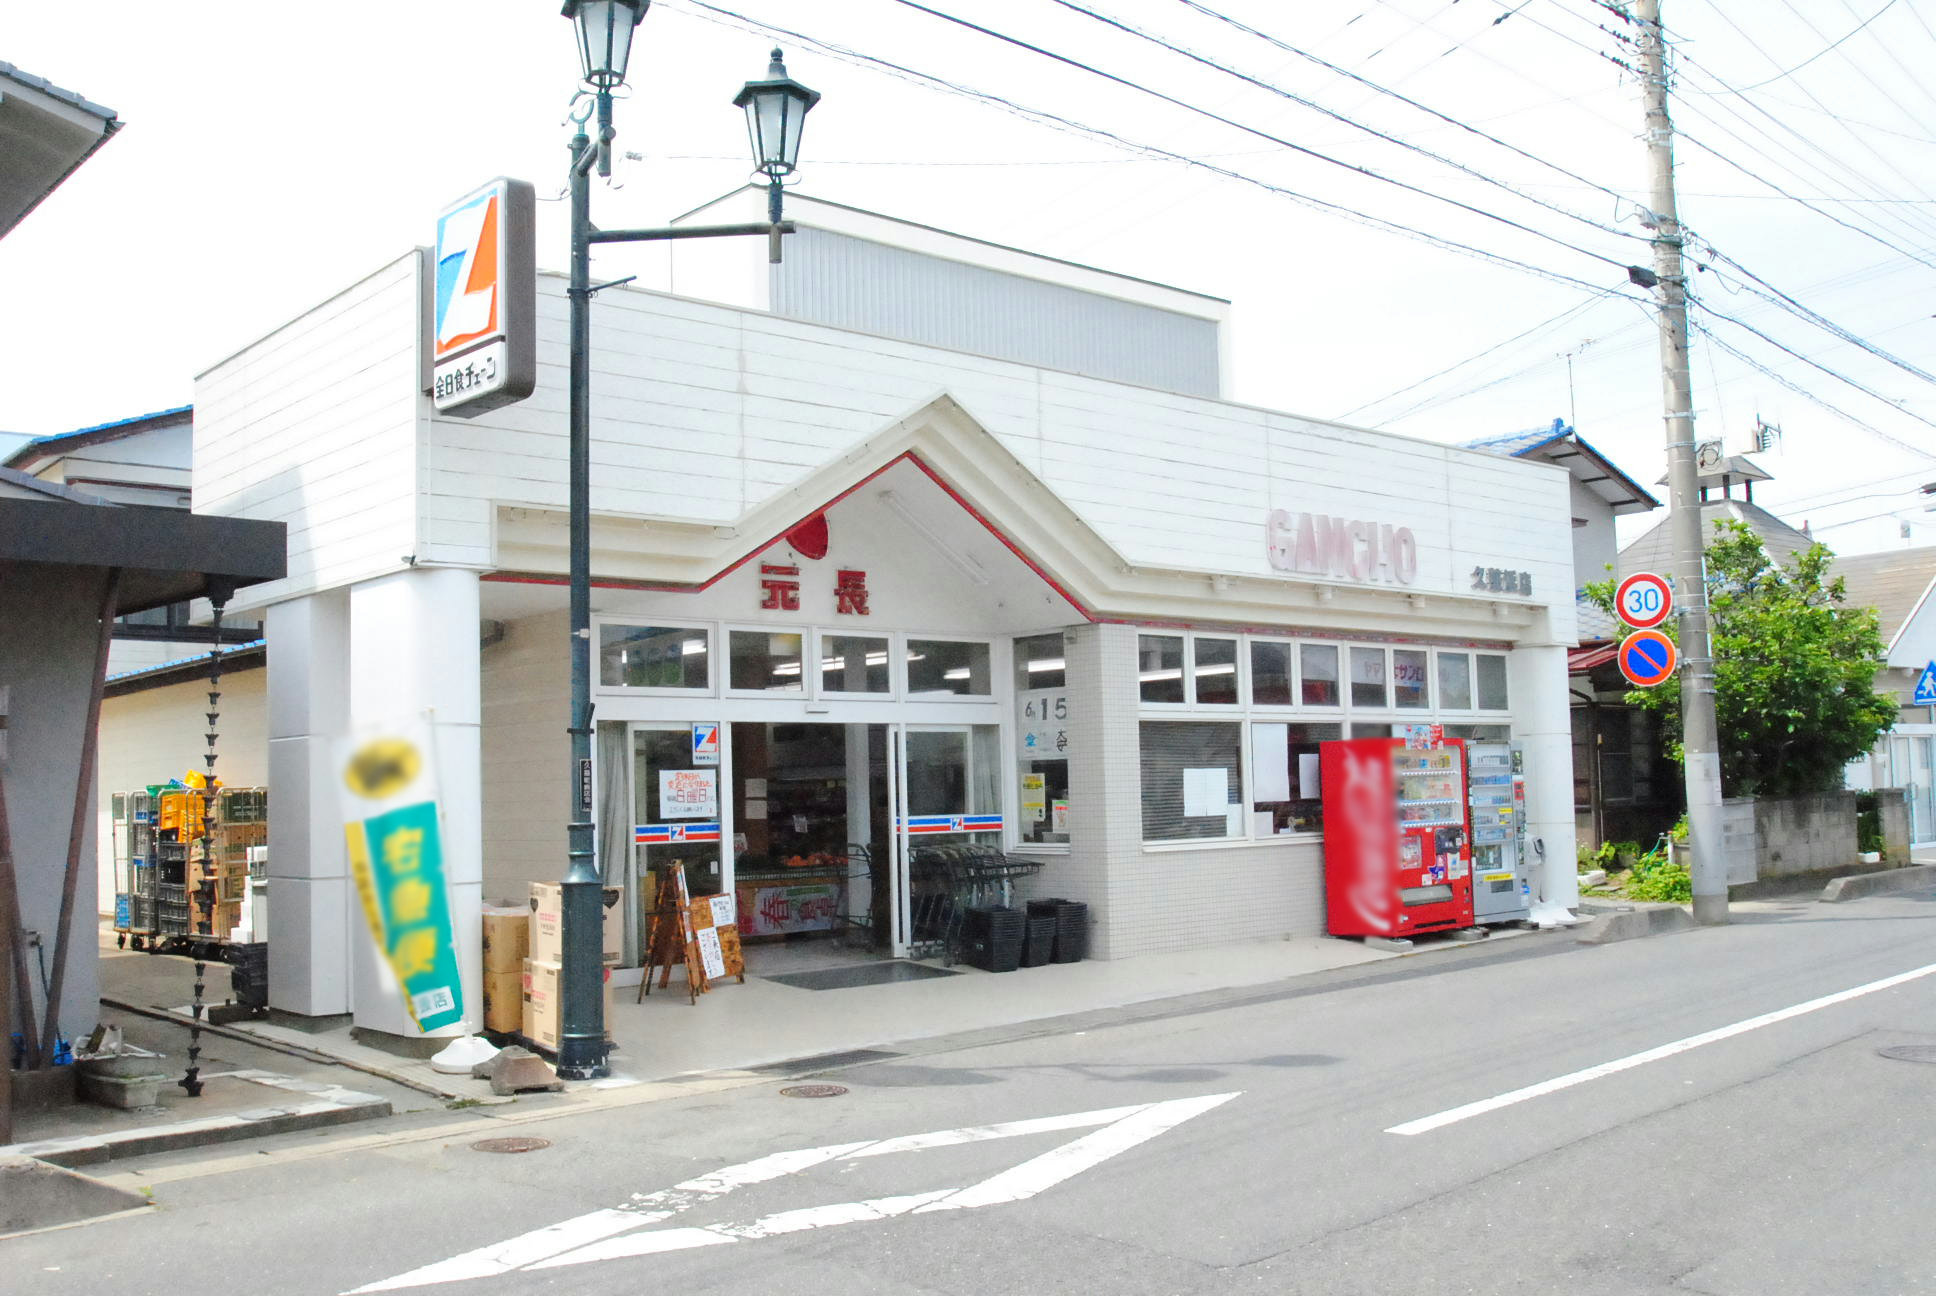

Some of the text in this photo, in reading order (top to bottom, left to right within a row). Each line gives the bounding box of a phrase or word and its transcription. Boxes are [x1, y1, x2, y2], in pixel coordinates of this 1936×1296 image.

[436, 356, 496, 399] 全日食チェーン
[1629, 588, 1659, 613] 30
